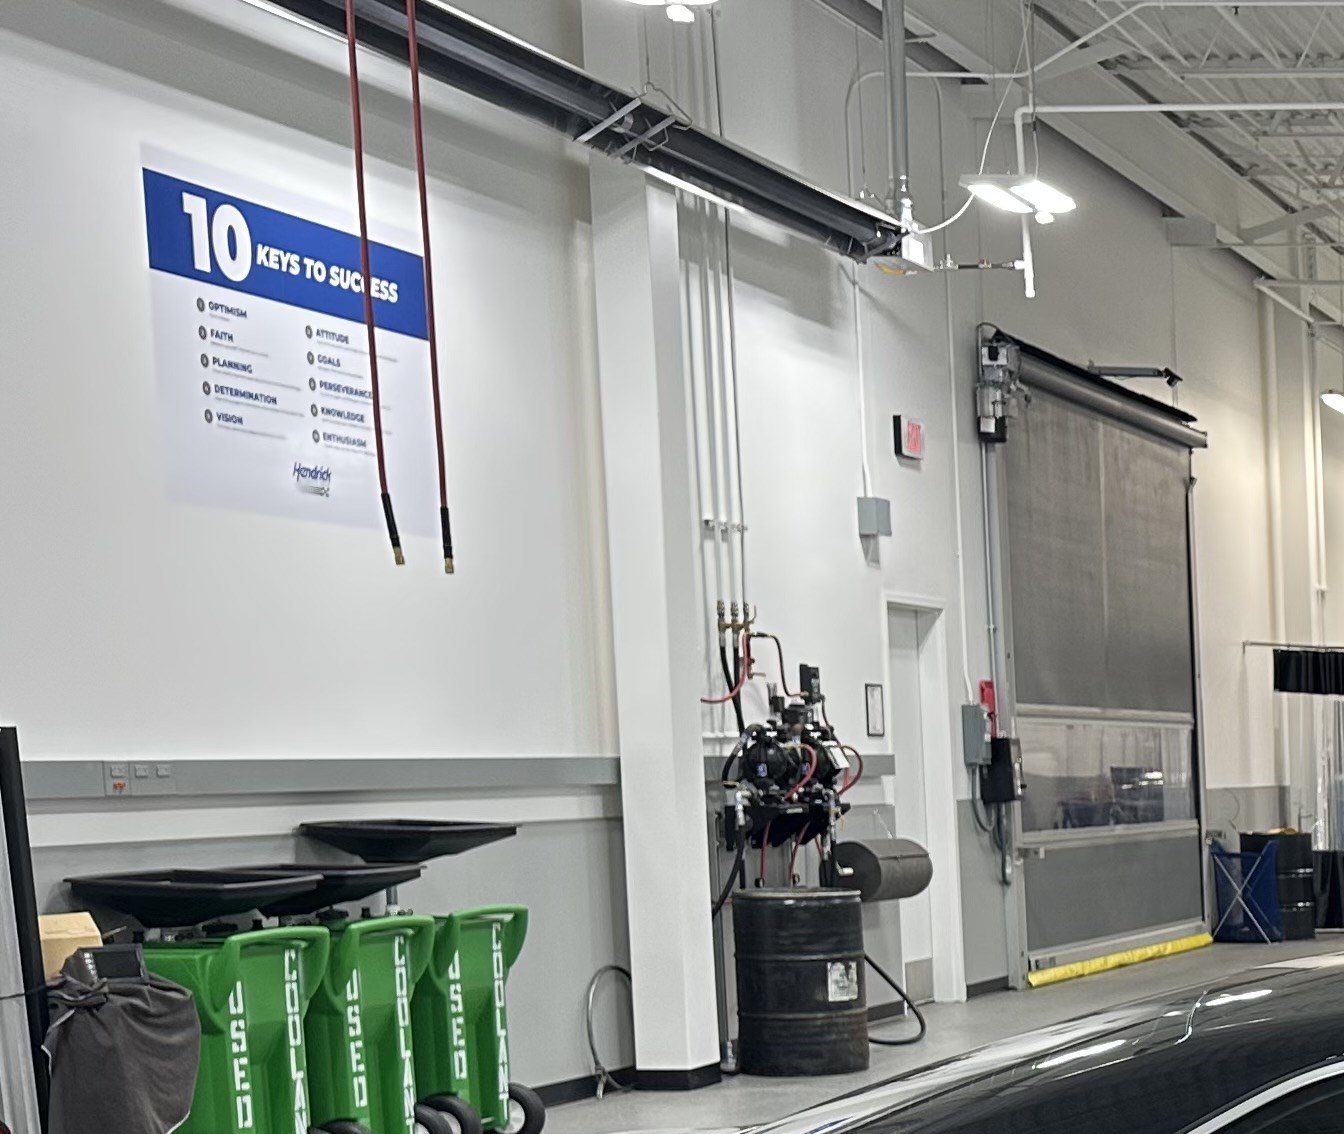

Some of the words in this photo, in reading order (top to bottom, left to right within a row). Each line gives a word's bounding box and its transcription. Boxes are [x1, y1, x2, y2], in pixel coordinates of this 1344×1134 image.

[182, 192, 252, 282] 10
[256, 243, 300, 276] KEYS
[303, 258, 327, 283] TO
[208, 301, 248, 319] OPTIMISM
[210, 328, 234, 342] FAITH
[316, 328, 350, 345] ATTITUDE
[212, 356, 253, 374] PLANNING
[214, 384, 278, 405] DETERMINATION
[216, 411, 244, 425] VISION
[320, 406, 365, 424] KNOWLEDGE
[292, 461, 332, 483] Hendrick
[448, 950, 468, 1080] USED
[491, 922, 510, 1121] COOLANT
[346, 968, 368, 1108] USED
[228, 980, 253, 1130] USED
